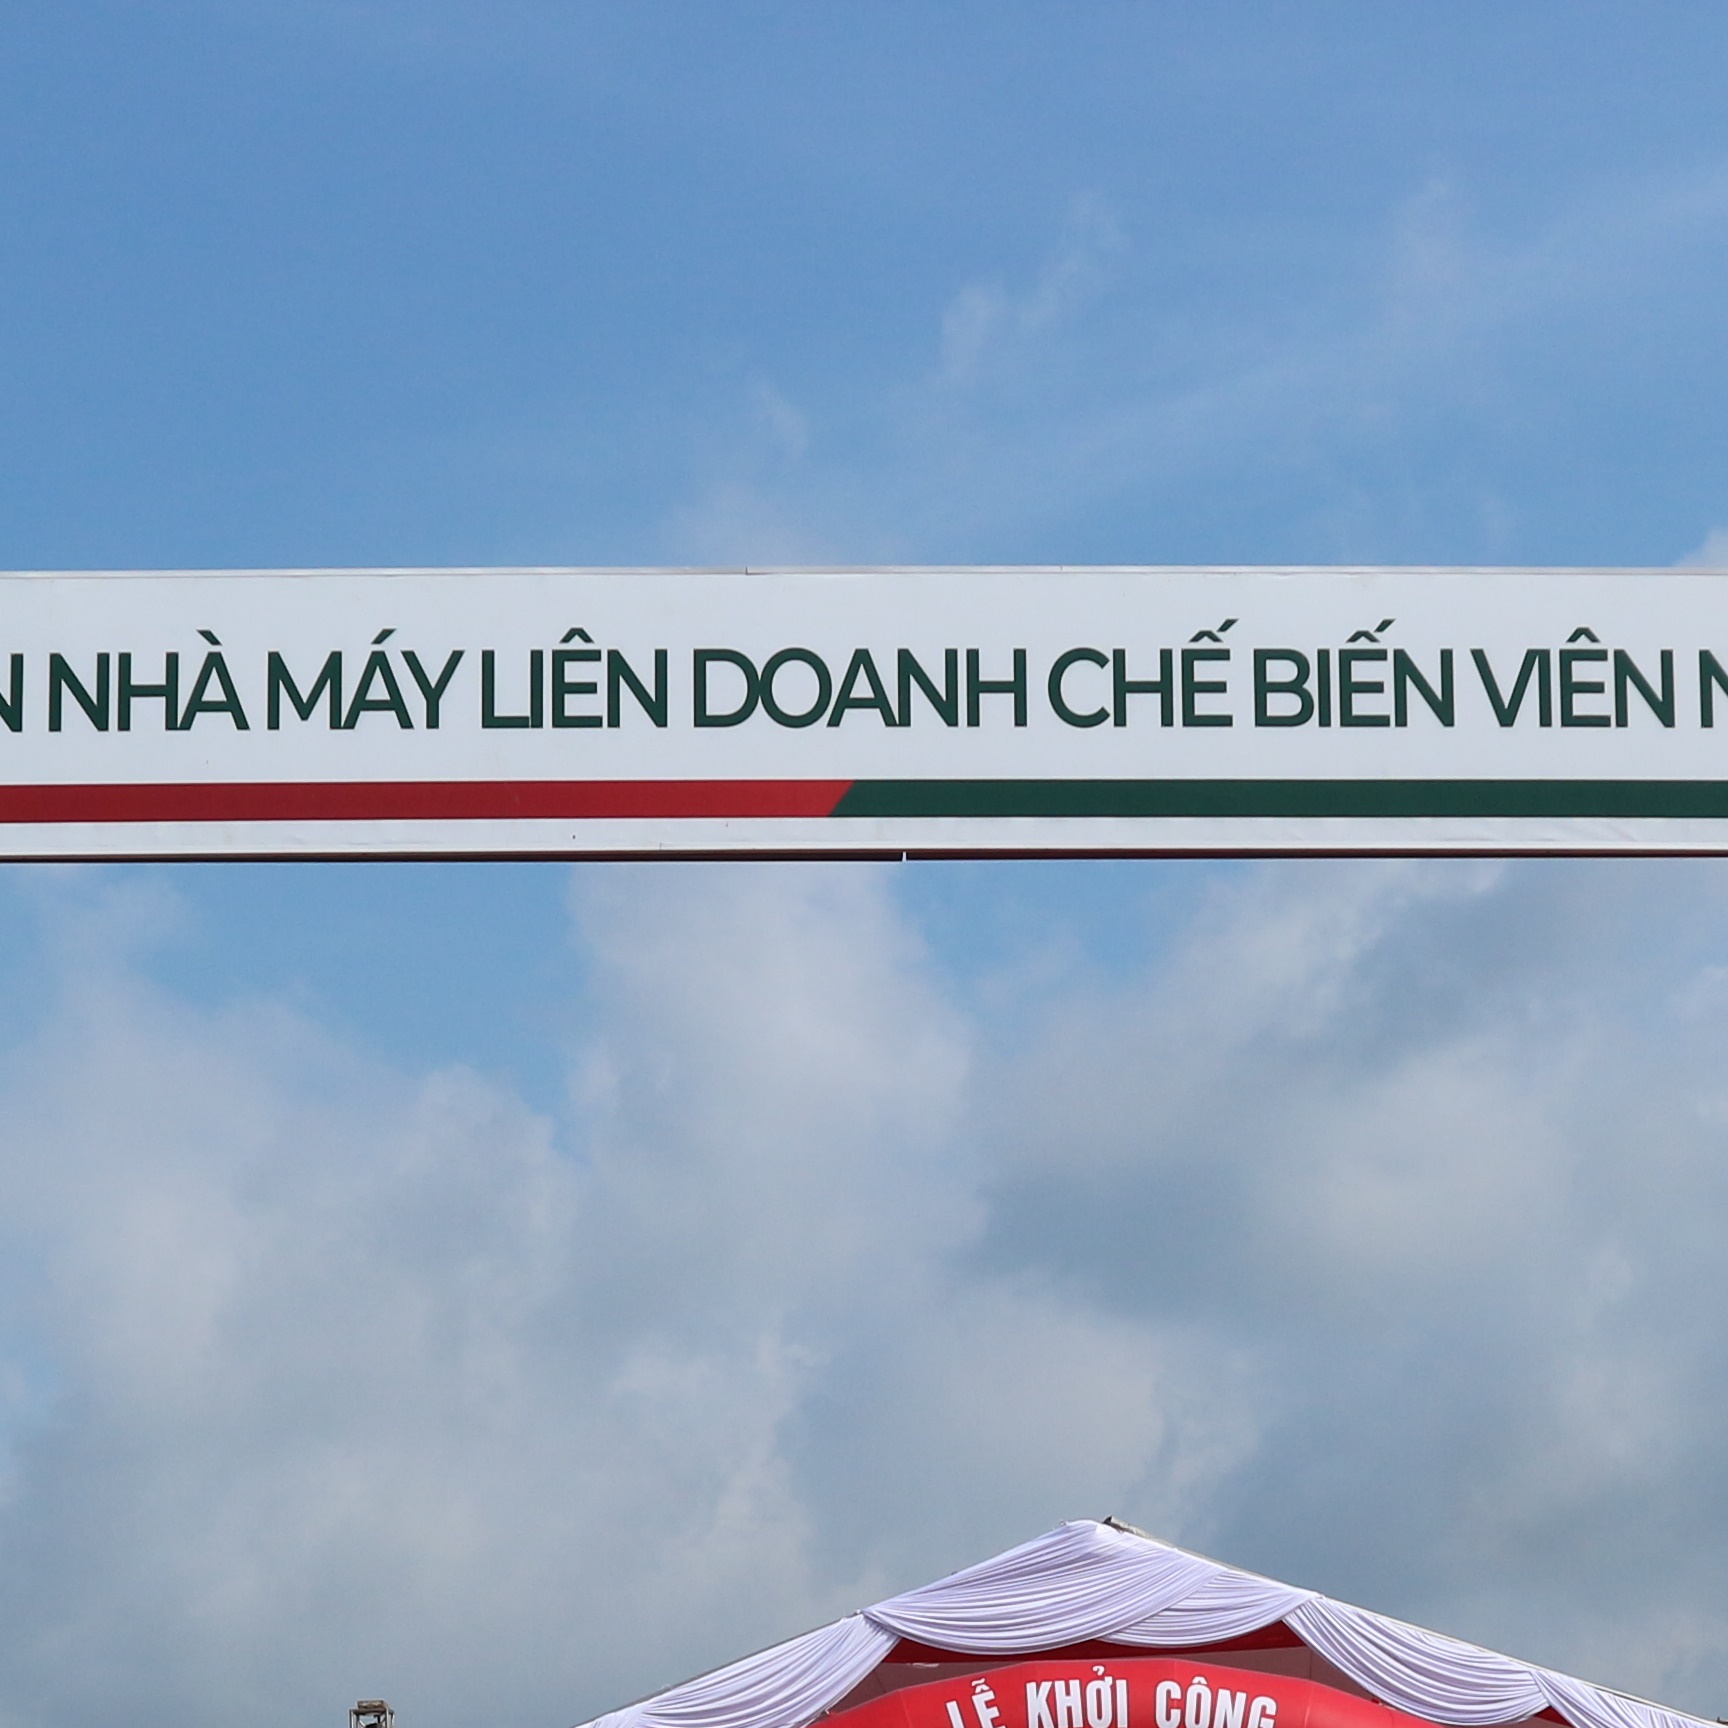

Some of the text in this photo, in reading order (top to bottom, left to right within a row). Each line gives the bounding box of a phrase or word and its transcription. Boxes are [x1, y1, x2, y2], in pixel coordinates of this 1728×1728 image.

[49, 631, 250, 732] NHÀ
[267, 629, 464, 730] MÁY
[482, 628, 667, 729] LIÊN
[694, 648, 1027, 728] DOANH
[1048, 623, 1234, 728] CHẾ
[1254, 620, 1454, 727] BIẾN
[1470, 628, 1675, 728] VIÊN
